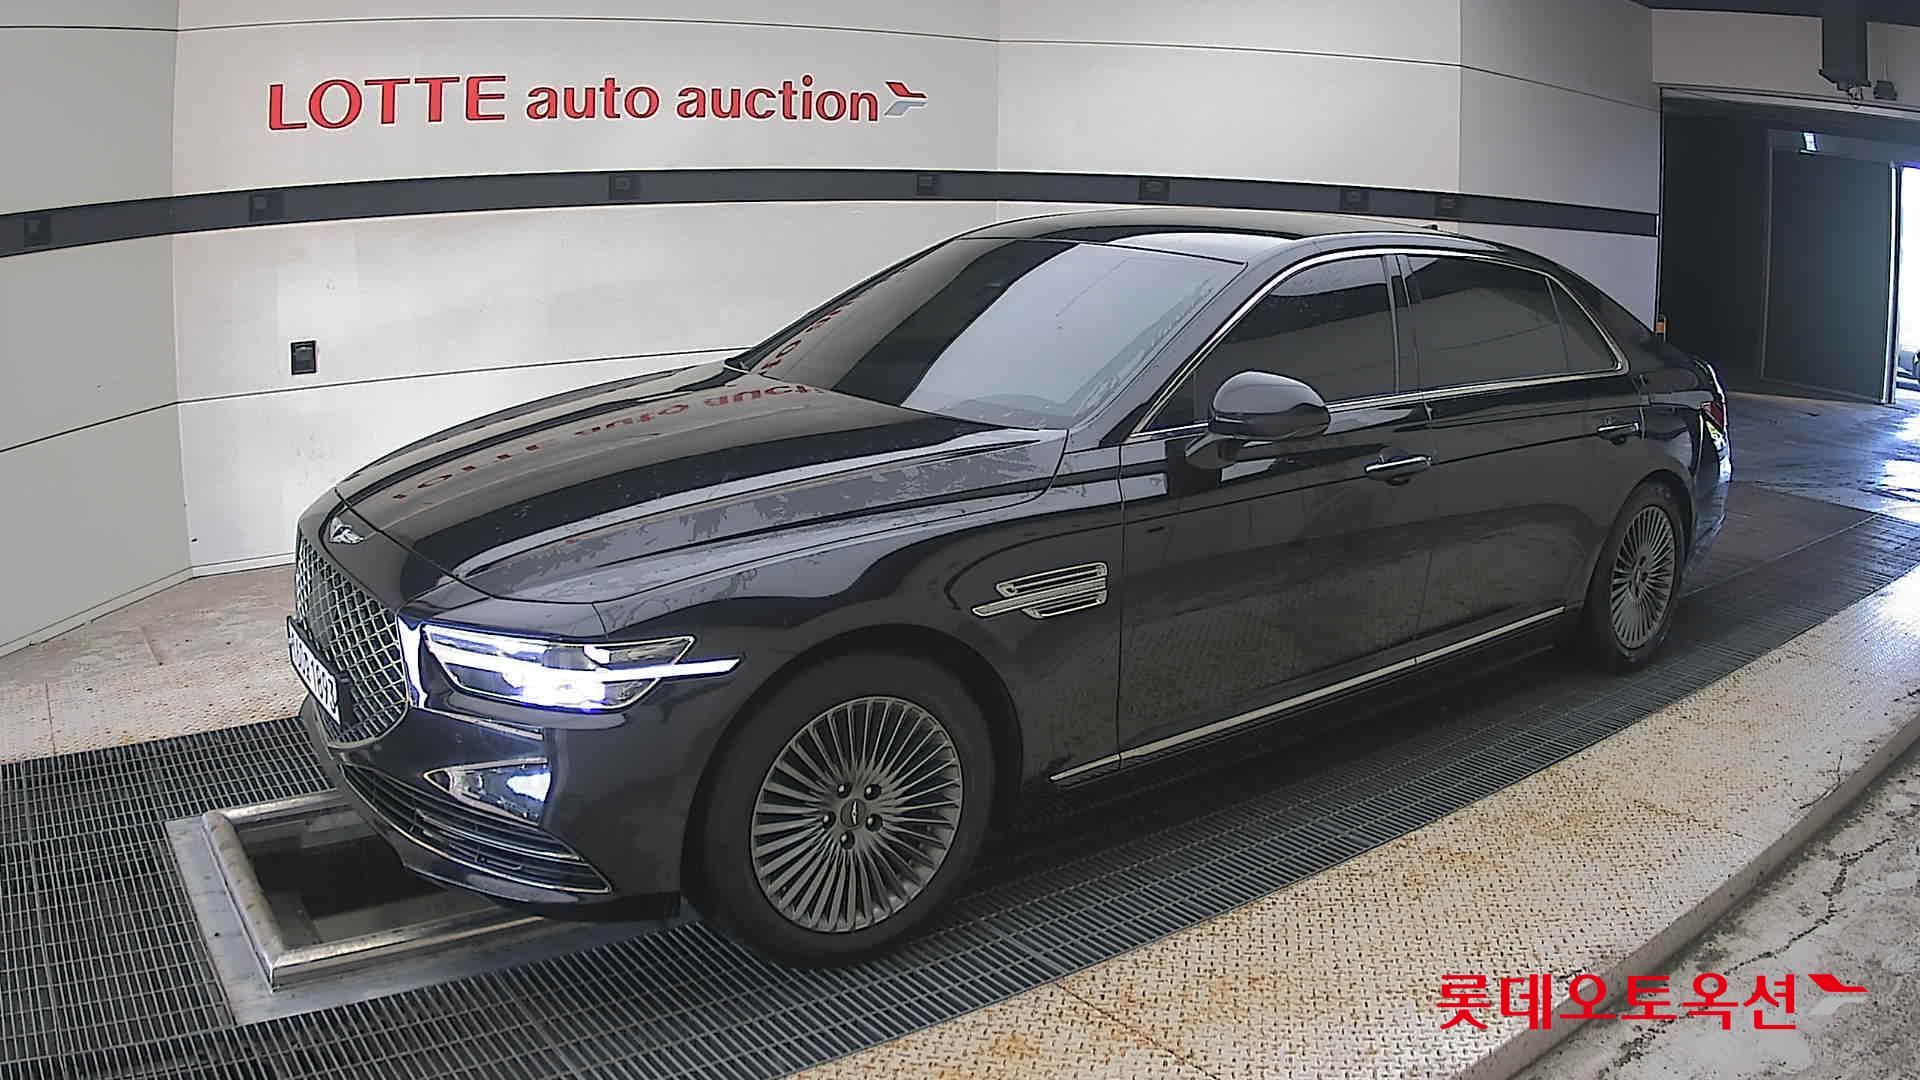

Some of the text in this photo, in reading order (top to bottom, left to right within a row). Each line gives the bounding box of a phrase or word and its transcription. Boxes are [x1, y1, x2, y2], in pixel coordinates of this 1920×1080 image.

[269, 75, 879, 131] LOTTE auto auction
